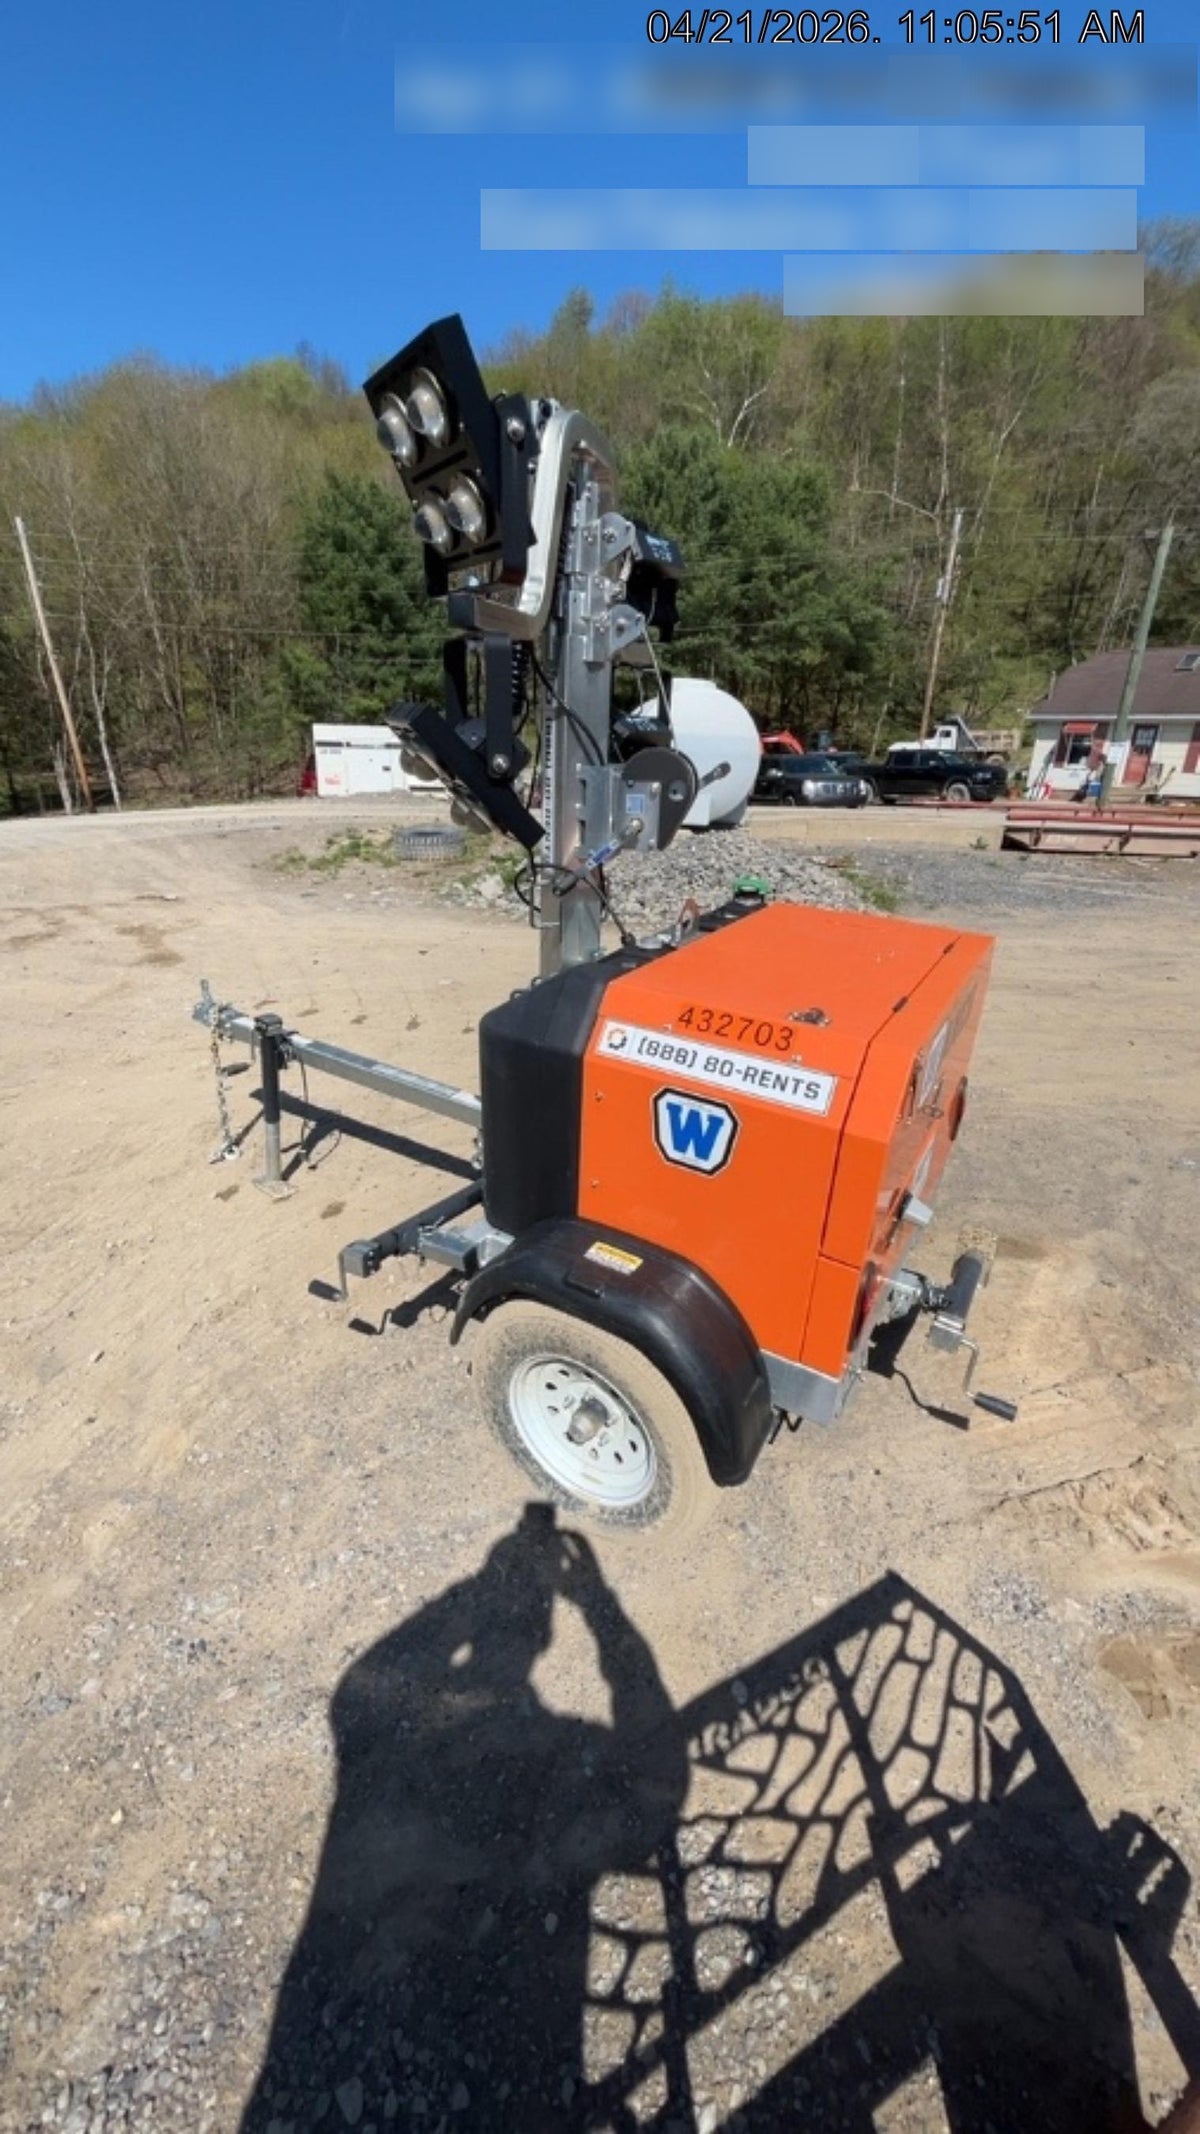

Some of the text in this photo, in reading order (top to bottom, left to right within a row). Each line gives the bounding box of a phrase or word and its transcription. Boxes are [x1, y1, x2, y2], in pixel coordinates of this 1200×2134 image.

[677, 1006, 793, 1052] 432703
[703, 1055, 821, 1100] 80-RENTS
[665, 1101, 724, 1161] W
